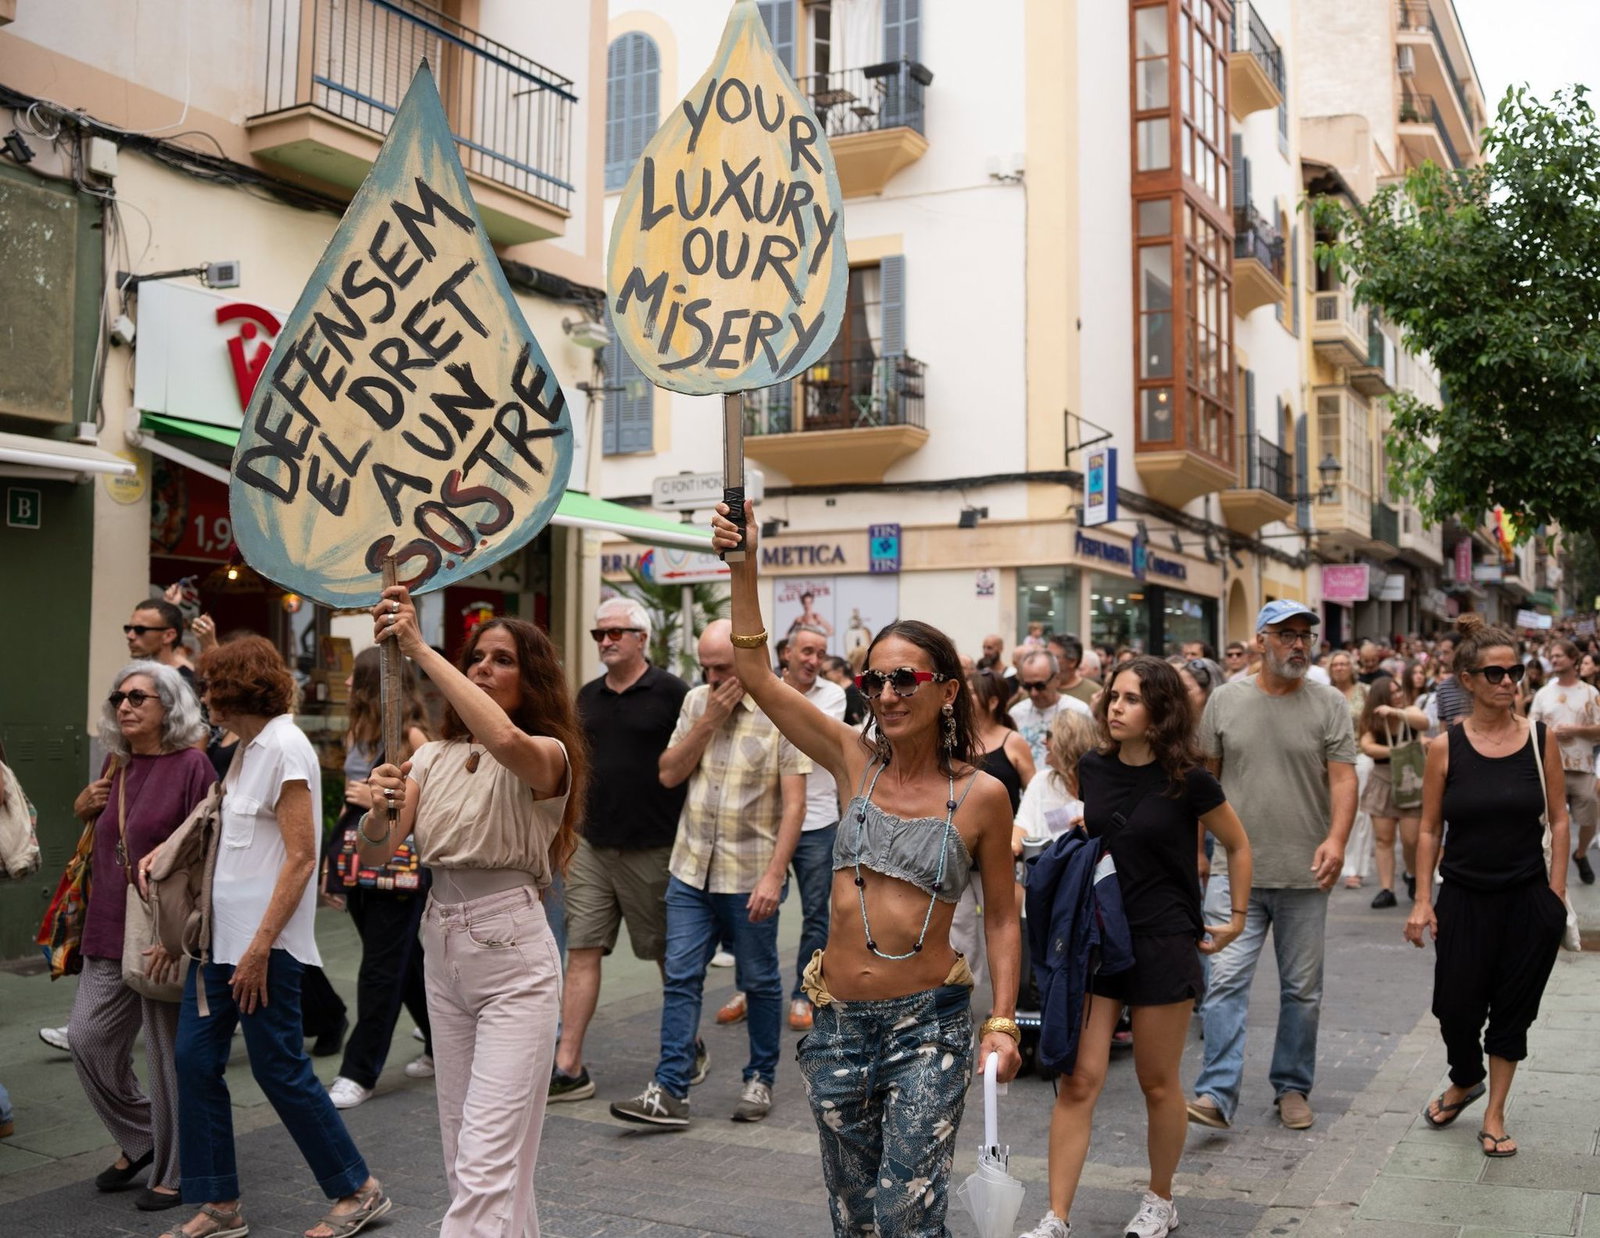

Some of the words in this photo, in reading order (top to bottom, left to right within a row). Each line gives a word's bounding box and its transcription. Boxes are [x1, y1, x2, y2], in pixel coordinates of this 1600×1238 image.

[683, 78, 823, 174] YOUR
[640, 156, 838, 275] LUXURY
[682, 226, 805, 306] OUR
[236, 176, 476, 504] DEFENSEM
[307, 433, 373, 517] EL
[345, 258, 491, 431] DRET
[401, 361, 497, 461] UN
[17, 497, 31, 518] B
[372, 462, 433, 527] A
[701, 476, 723, 488] MON
[870, 525, 898, 537] TIN
[870, 559, 898, 571] TIN
